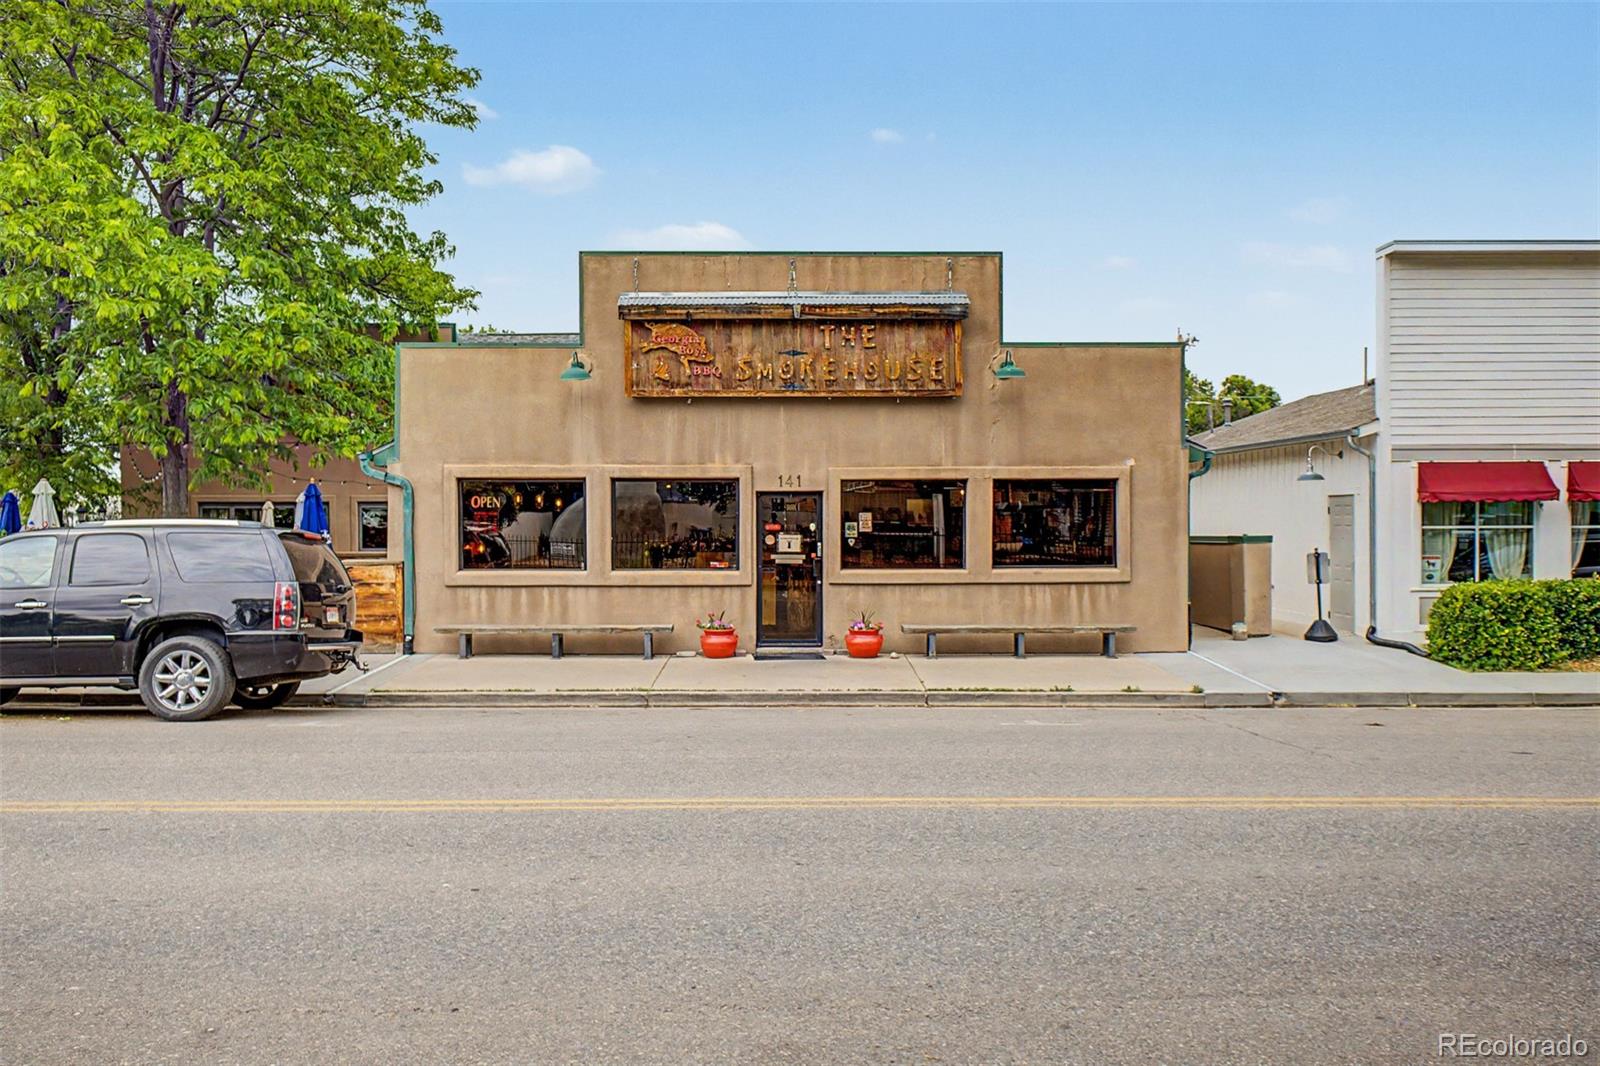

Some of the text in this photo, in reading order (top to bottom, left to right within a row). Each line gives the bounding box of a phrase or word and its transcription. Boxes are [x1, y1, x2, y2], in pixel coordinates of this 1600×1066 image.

[819, 323, 876, 350] THE
[693, 365, 722, 378] BBQ
[735, 356, 945, 382] SMOKEHOUSE
[777, 474, 801, 488] 141
[470, 495, 501, 509] OPEN
